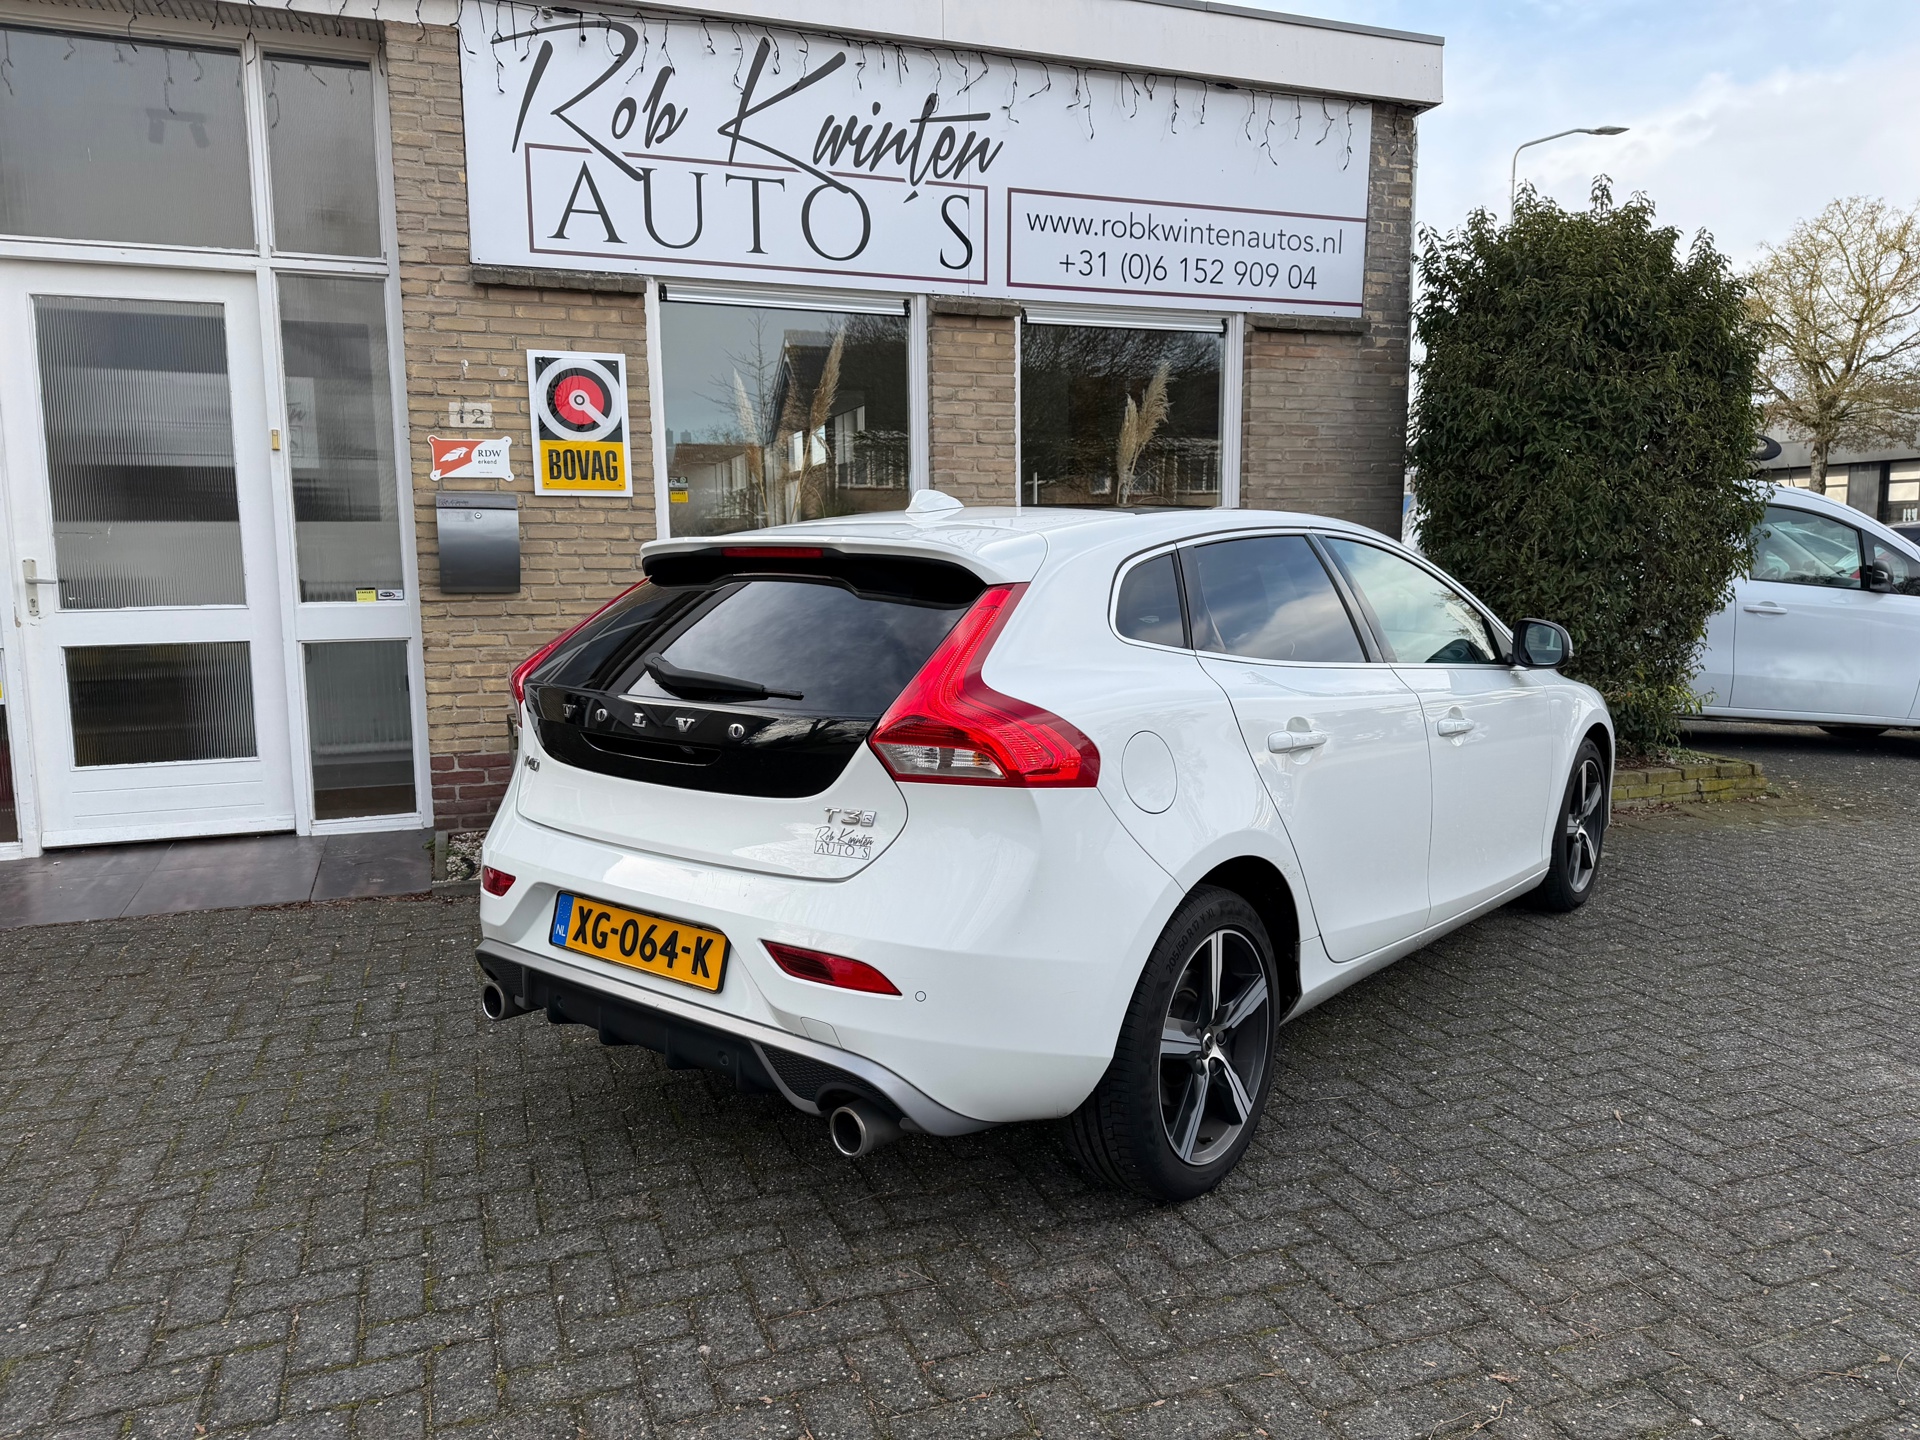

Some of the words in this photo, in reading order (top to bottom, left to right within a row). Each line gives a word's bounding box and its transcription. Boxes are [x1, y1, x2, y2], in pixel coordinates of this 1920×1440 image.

[490, 21, 688, 181] Rob
[718, 37, 1003, 193] Kwinten
[1026, 211, 1343, 255] www.robkwintenautos.nl
[1059, 250, 1107, 277] +31
[1120, 252, 1168, 285] (0)6
[1179, 257, 1224, 285] 152
[1234, 260, 1279, 288] 909
[1287, 264, 1317, 290] 04
[477, 449, 501, 458] RDW
[547, 448, 619, 482] BOVAG
[562, 703, 745, 739] VOLVO
[824, 807, 862, 825] T3
[815, 825, 835, 845] Rob
[555, 923, 566, 937] NL
[572, 906, 714, 979] XG-064-K
[1166, 936, 1188, 974] 205/50
[1187, 928, 1195, 939] R
